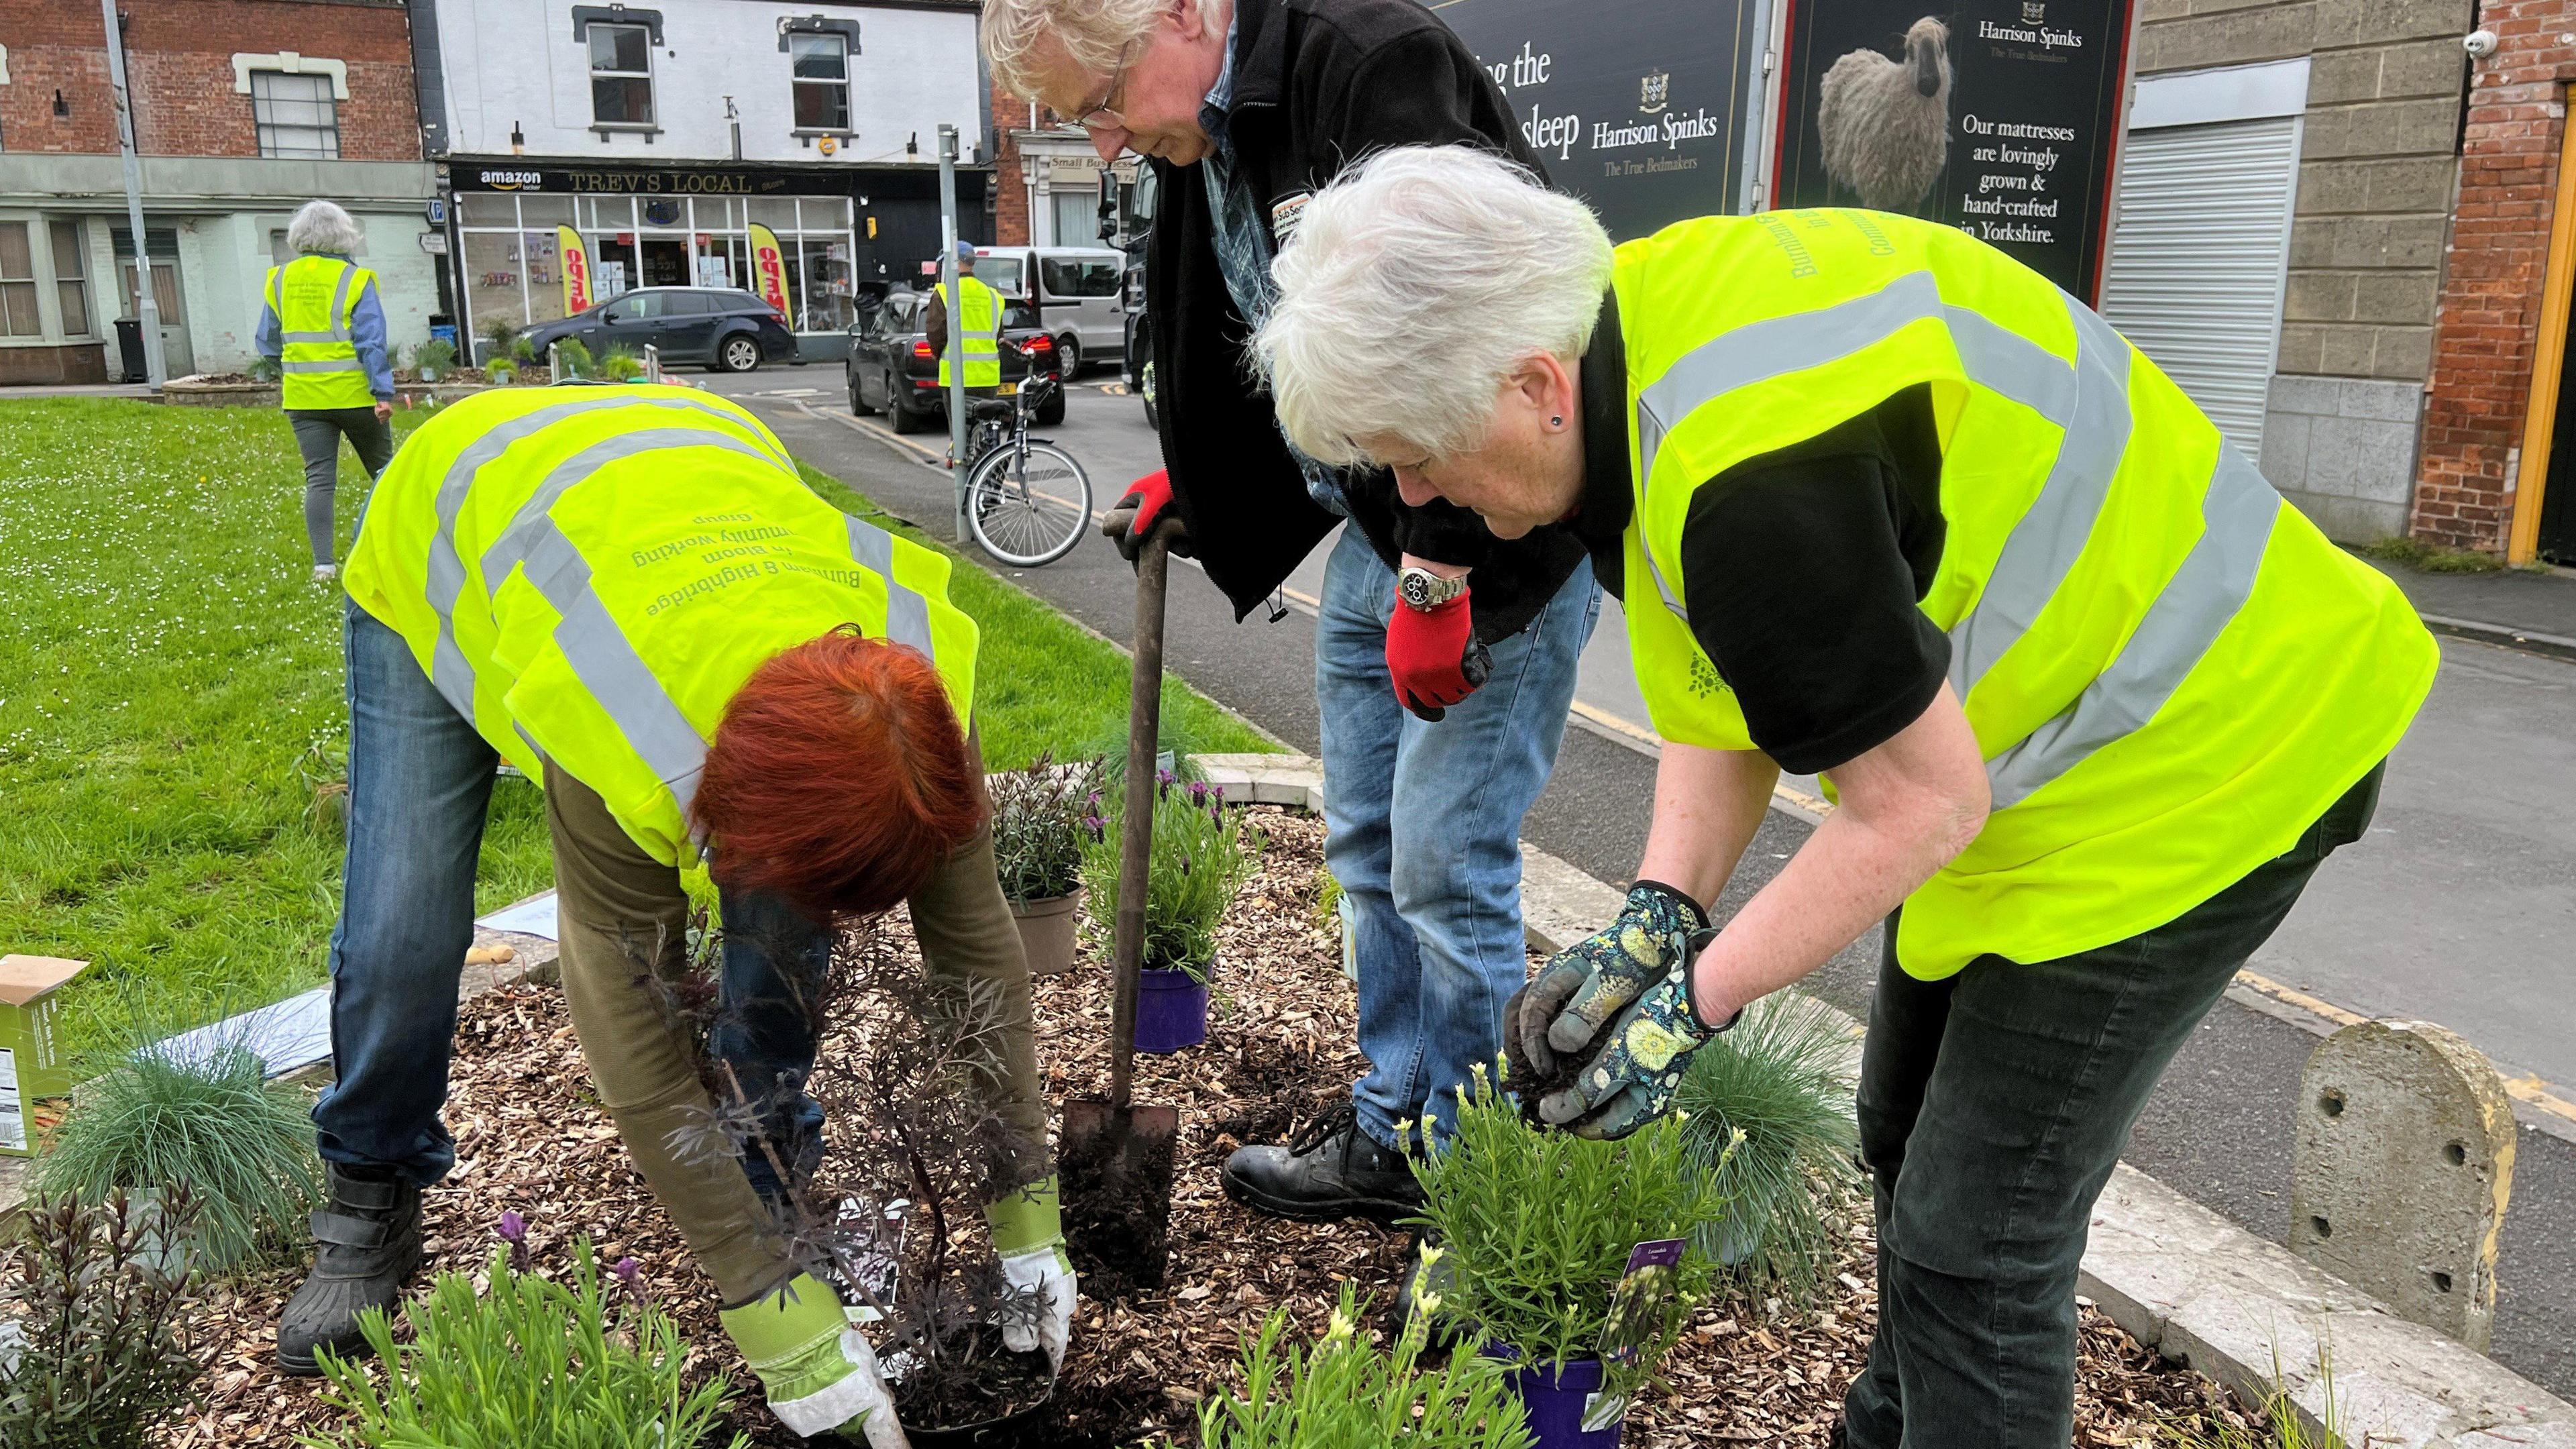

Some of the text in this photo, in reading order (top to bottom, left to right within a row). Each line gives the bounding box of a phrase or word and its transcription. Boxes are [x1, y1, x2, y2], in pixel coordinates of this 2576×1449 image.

[1979, 20, 2082, 50] Harrison Spinks
[1513, 40, 1551, 87] the
[1521, 103, 1580, 160] sleep
[1591, 107, 1717, 150] Harrison Spinks
[1963, 113, 2074, 142] Our mattresses
[1051, 158, 1082, 167] Small
[1605, 154, 1697, 177] The True Bedmakers
[1973, 143, 2059, 172] are lovingly
[481, 171, 541, 184] amazon
[570, 172, 752, 193] TREV'S LOCAL
[1979, 173, 2045, 194] grown &
[1962, 193, 2058, 218] hand-crafted
[1961, 221, 2054, 243] in Yorkshire.
[1768, 223, 1819, 280] Burnham
[565, 249, 588, 313] OPEN
[758, 247, 786, 312] OPEN
[692, 513, 753, 525] Group
[631, 535, 717, 568] Working
[701, 545, 769, 564] Bloom
[764, 560, 780, 575] &
[645, 562, 761, 617] Highbridge
